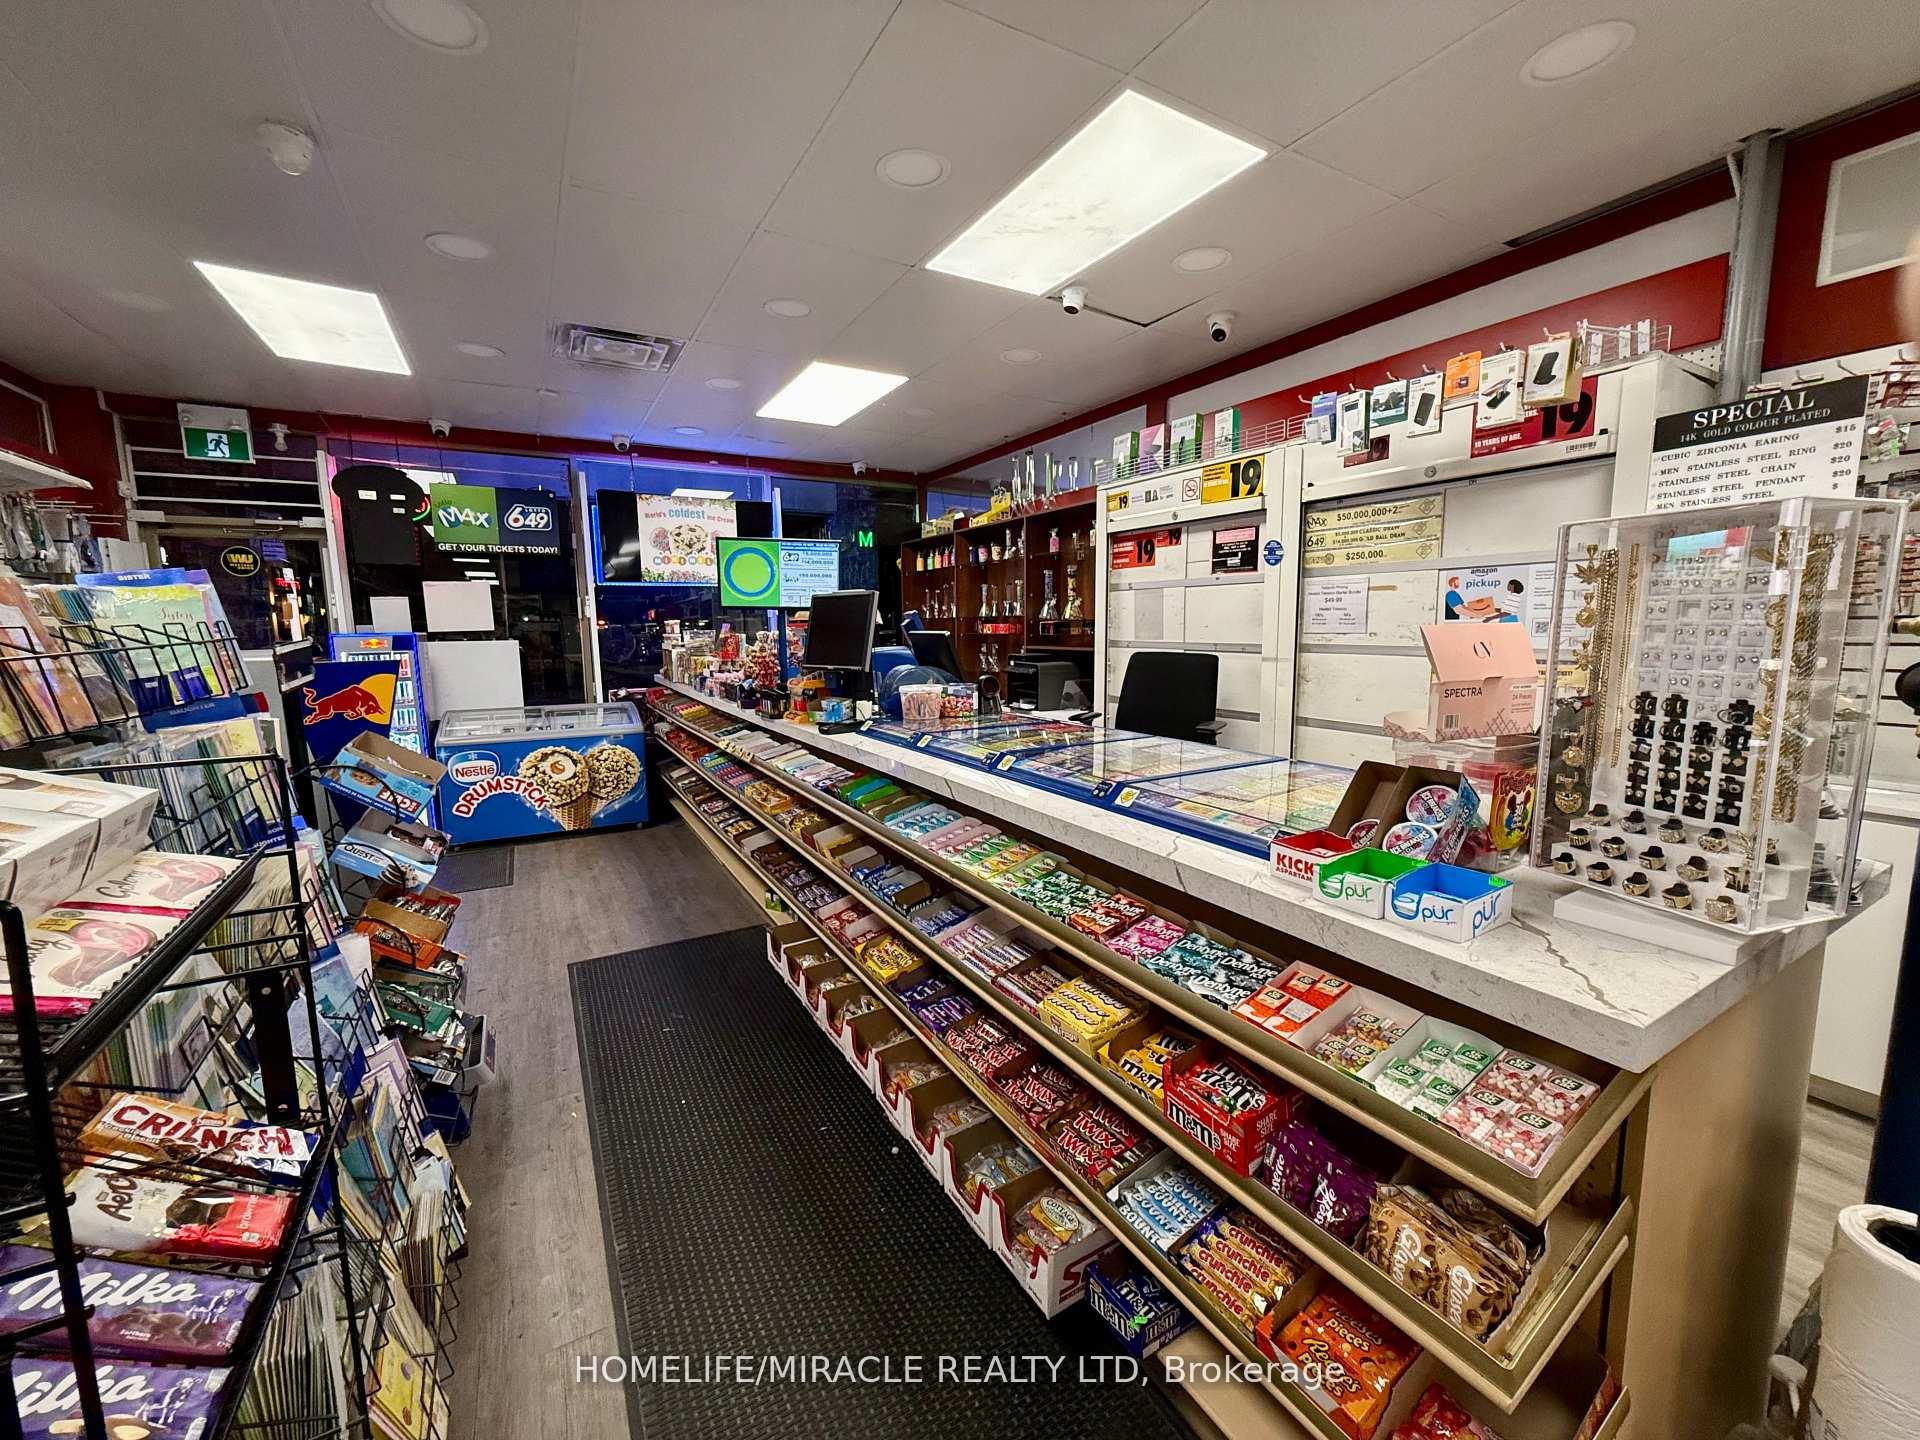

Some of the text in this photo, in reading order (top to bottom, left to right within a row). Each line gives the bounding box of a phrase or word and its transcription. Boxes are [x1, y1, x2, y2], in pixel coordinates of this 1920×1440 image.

[1541, 389, 1593, 441] 19
[1693, 389, 1816, 430] SPECIAL
[1680, 407, 1831, 443] 14K GOLD COLOUR PLATED
[1661, 423, 1857, 463] CUBIC ZIRCONIA EARING $15
[1659, 466, 1680, 477] MEN
[1687, 456, 1740, 472] STAINLESS
[1746, 450, 1782, 464] STEEL
[1788, 445, 1817, 458] RING
[1230, 458, 1262, 499] 19
[1657, 473, 1711, 488] STAINLESS
[1716, 467, 1751, 481] STEEL
[1760, 461, 1796, 474] CHAIN
[1656, 486, 1707, 500] STAINLESS
[1711, 482, 1744, 493] STEEL
[1755, 474, 1806, 488] PENDANT
[1741, 489, 1775, 500] STEEL
[668, 507, 706, 519] coldest
[1118, 494, 1129, 510] 19
[438, 506, 490, 528] MAX
[438, 543, 558, 554] GET YOUR TICKETS TODAY!
[859, 530, 873, 548] M
[1135, 538, 1156, 564] 19
[117, 573, 152, 582] SISTER
[1470, 567, 1499, 575] amazon
[1465, 578, 1501, 590] pickup
[1444, 686, 1483, 699] SPECTRA
[343, 843, 375, 861] QUEST
[1276, 852, 1315, 874] KICK
[1275, 865, 1314, 883] ASPARTAM
[1079, 908, 1121, 925] Dentyne
[1103, 898, 1146, 915] Dentyne
[1135, 920, 1183, 939] Dentyne
[1150, 954, 1200, 976] Dentyne
[1221, 955, 1280, 978] Dentyne
[1195, 975, 1252, 999] Dentyne
[1073, 1111, 1116, 1149] TWIX
[1167, 1096, 1223, 1152] m&m's
[1256, 1109, 1279, 1132] SHARE
[1260, 1124, 1276, 1139] SIZE
[1057, 1127, 1099, 1166] TWIX
[1045, 1198, 1077, 1227] COTTAGE
[1118, 1204, 1163, 1246] BOUNT
[1228, 1225, 1284, 1270] crunchie
[1198, 1248, 1254, 1295] crunchie
[1214, 1238, 1271, 1283] crunchie
[8, 1269, 204, 1314] Milka
[1189, 1266, 1244, 1316] crunchie
[1325, 1316, 1372, 1353] pieces
